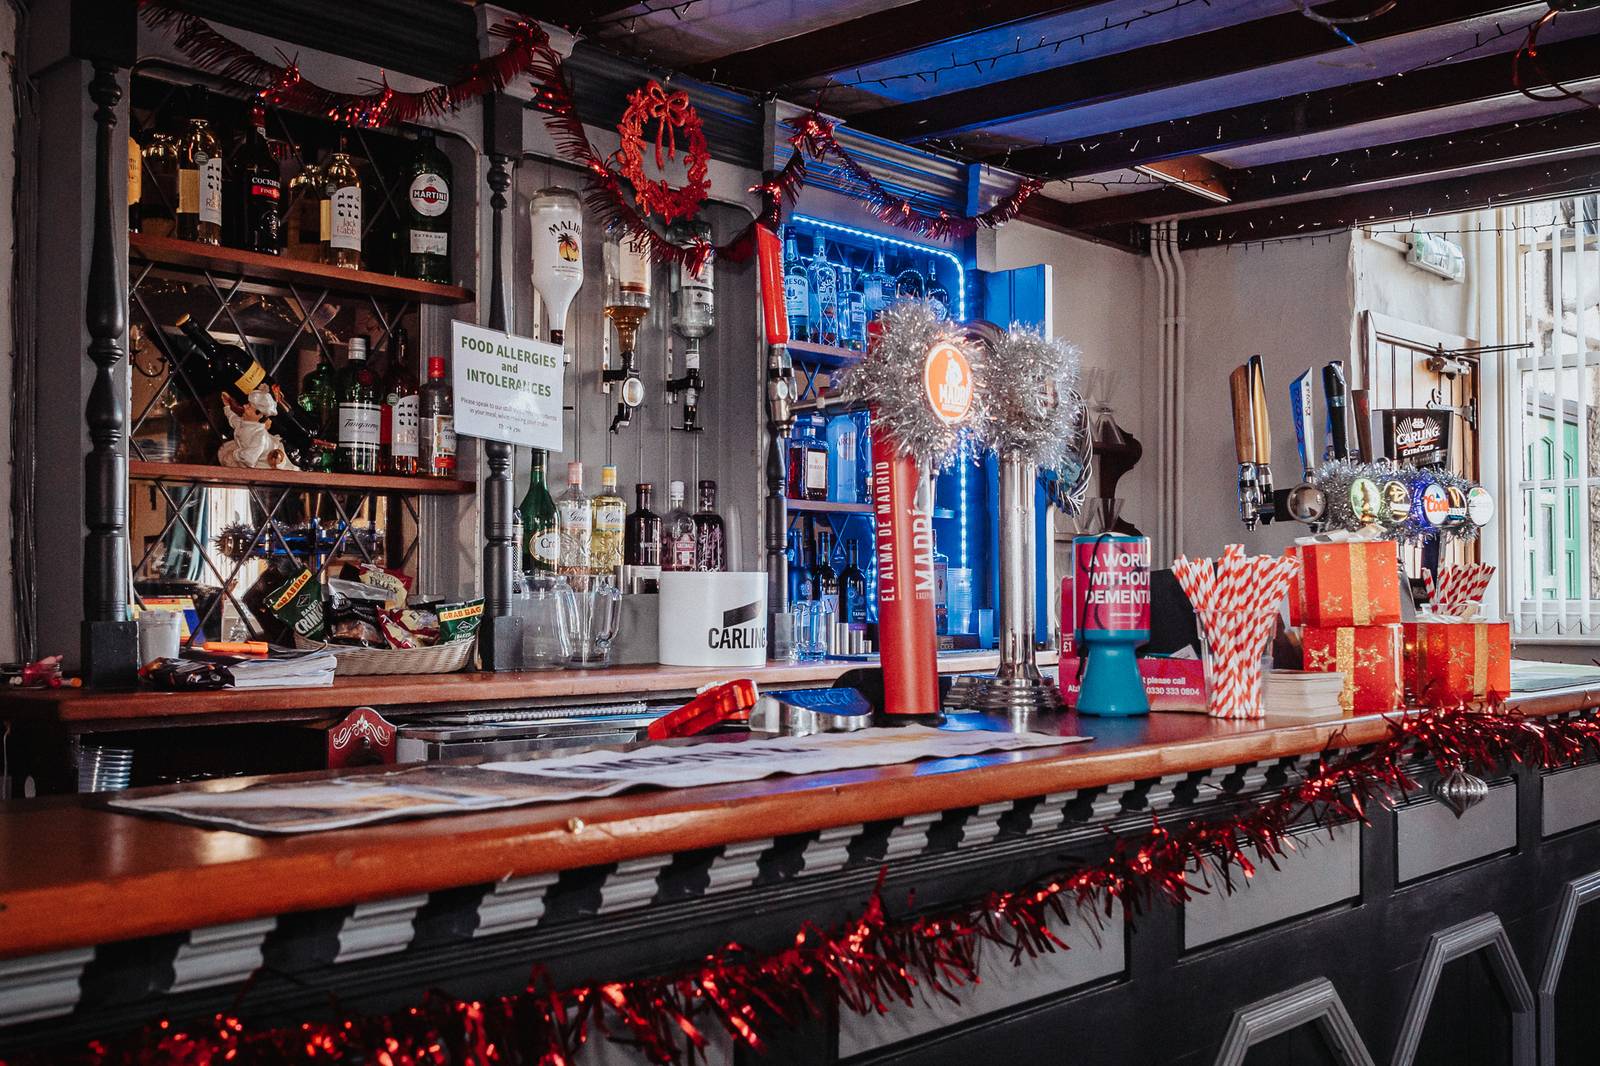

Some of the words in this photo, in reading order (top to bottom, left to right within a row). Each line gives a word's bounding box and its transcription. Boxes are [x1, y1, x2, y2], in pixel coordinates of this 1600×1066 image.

[413, 190, 448, 201] MARTINI
[784, 277, 806, 287] MESON
[461, 336, 494, 354] FOOD
[496, 345, 557, 369] ALLERGIES
[501, 362, 518, 374] and
[467, 368, 551, 397] INTOLERANCES
[1397, 426, 1441, 445] CARLING
[875, 461, 891, 515] MADRID
[878, 520, 892, 537] DE
[879, 543, 894, 585] ALMA
[1088, 554, 1101, 568] A
[369, 575, 400, 594] FRIES
[881, 586, 895, 602] EL
[443, 610, 464, 619] GRAB
[464, 606, 482, 616] BAG
[1062, 641, 1072, 653] £1
[1146, 677, 1171, 685] please
[1172, 677, 1186, 685] call
[1165, 687, 1180, 695] 333
